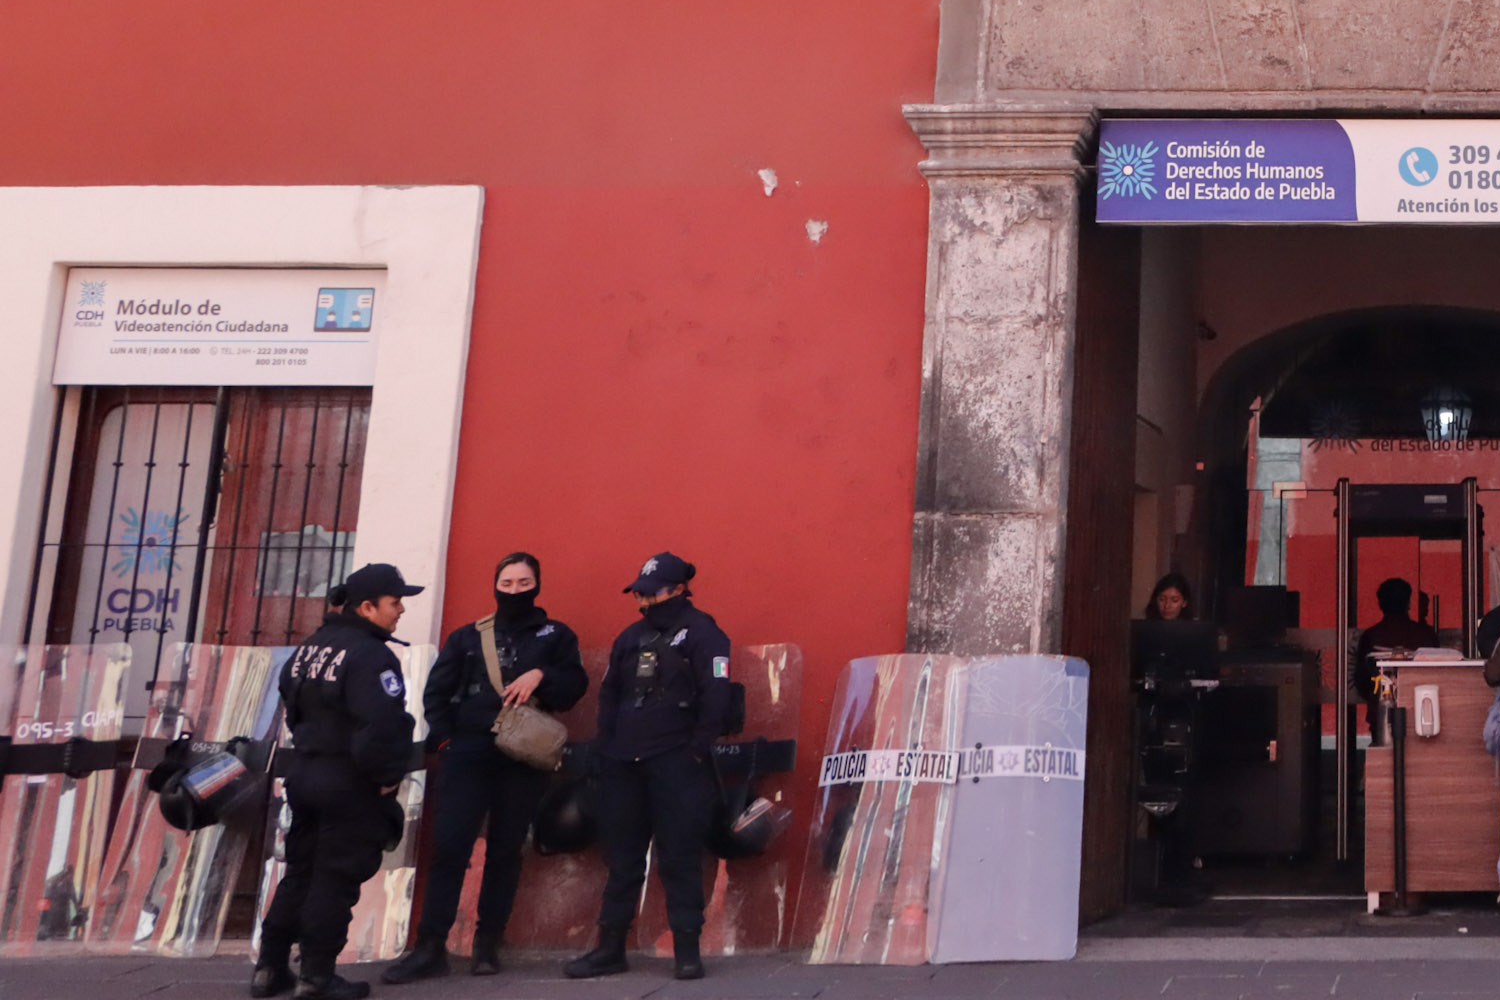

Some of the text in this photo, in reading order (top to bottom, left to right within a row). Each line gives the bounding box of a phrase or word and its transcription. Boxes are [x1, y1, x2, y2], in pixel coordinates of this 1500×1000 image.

[1166, 140, 1266, 159] Comisión de
[1448, 145, 1490, 164] 309
[1166, 161, 1324, 179] Derechos Humanos
[1165, 181, 1336, 200] del Estado de Puebla
[1397, 198, 1469, 213] Atención
[1474, 198, 1498, 213] los
[76, 310, 104, 320] CDH
[116, 298, 221, 316] Módulo de
[114, 319, 289, 333] Videoatención Ciudadana
[1371, 437, 1393, 451] del
[1400, 437, 1450, 451] Estado
[1456, 437, 1474, 451] de
[107, 588, 180, 613] CDH
[103, 617, 174, 631] PUEBLA
[16, 721, 74, 739] 095-3
[823, 752, 953, 781] POLICIA ESTATAL
[960, 748, 1079, 776] LICIA ESTATAL
